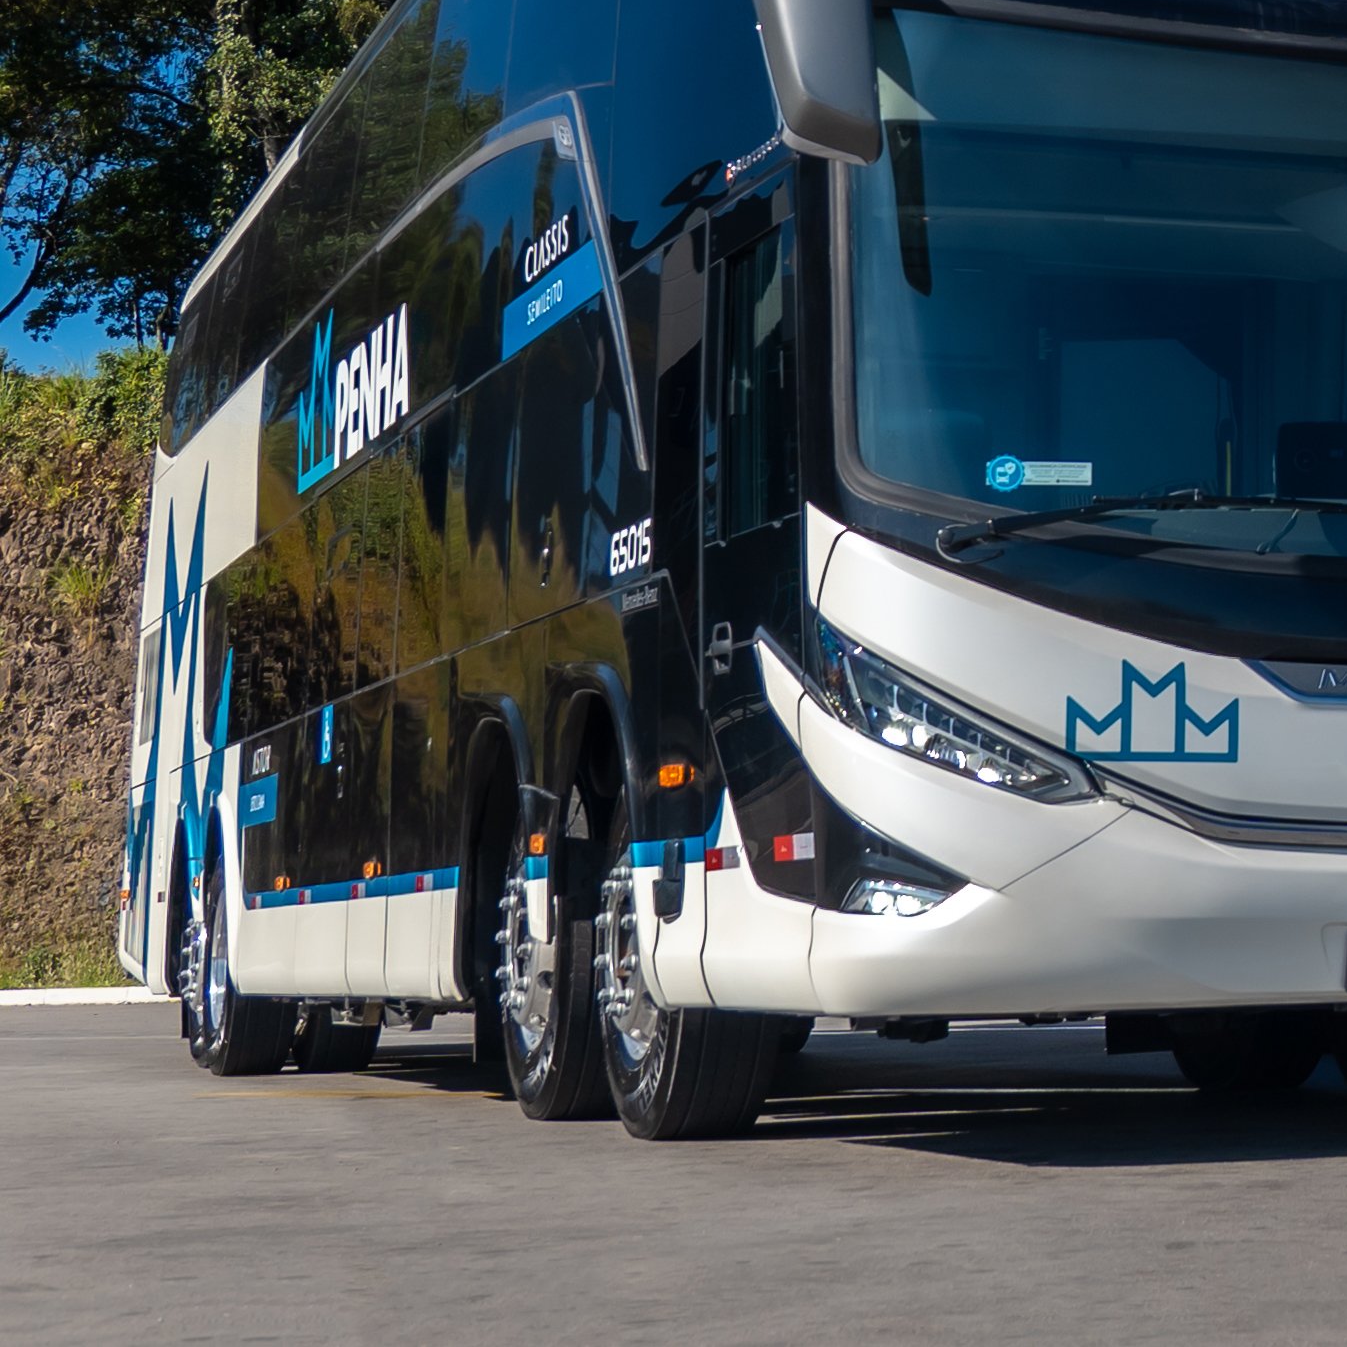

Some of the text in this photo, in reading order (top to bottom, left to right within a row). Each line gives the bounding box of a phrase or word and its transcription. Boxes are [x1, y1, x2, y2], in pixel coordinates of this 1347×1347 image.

[524, 214, 569, 282] CLASSIS
[527, 279, 563, 326] SEMILEITO
[333, 302, 409, 470] PENHA
[610, 517, 652, 577] 65015
